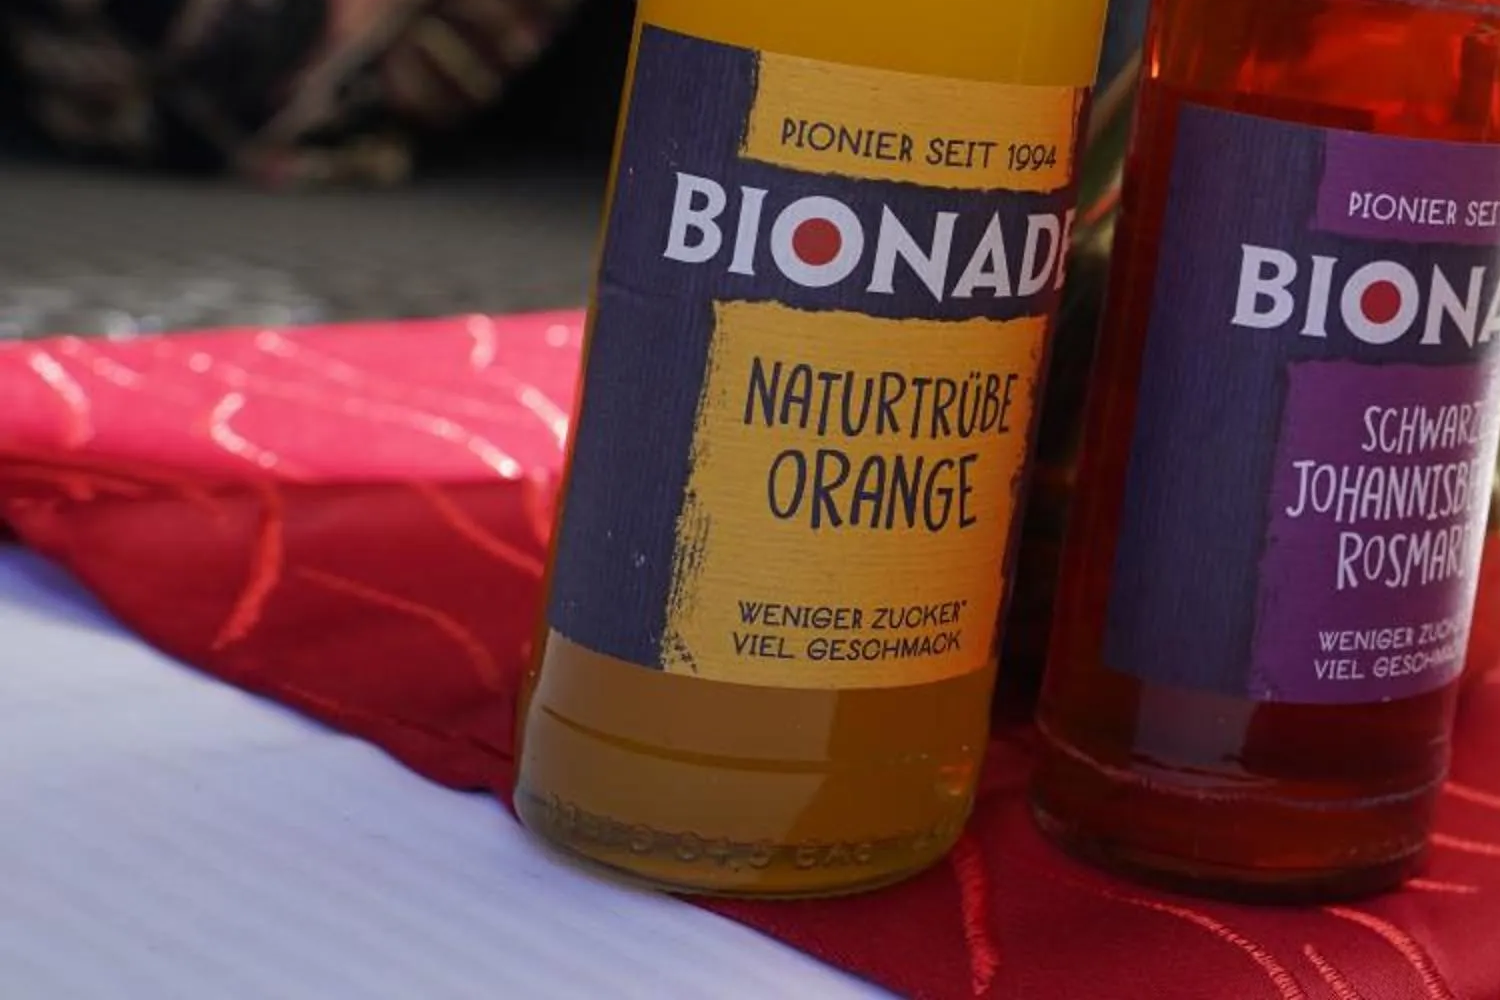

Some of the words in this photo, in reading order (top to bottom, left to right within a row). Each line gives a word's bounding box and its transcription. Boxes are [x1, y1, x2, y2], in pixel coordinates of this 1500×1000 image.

[781, 117, 914, 162] PIONIER
[924, 137, 999, 169] SEIT
[1007, 143, 1057, 172] 1994
[1348, 191, 1457, 226] PIONIER
[743, 356, 1019, 440] NATURTRÜBE
[767, 448, 979, 532] ORANGE
[737, 600, 863, 630] WENIGER
[731, 621, 796, 660] VIEL
[806, 620, 963, 662] GESCHMACK
[1318, 626, 1415, 652] WENIGER
[1313, 658, 1366, 681] VIEL
